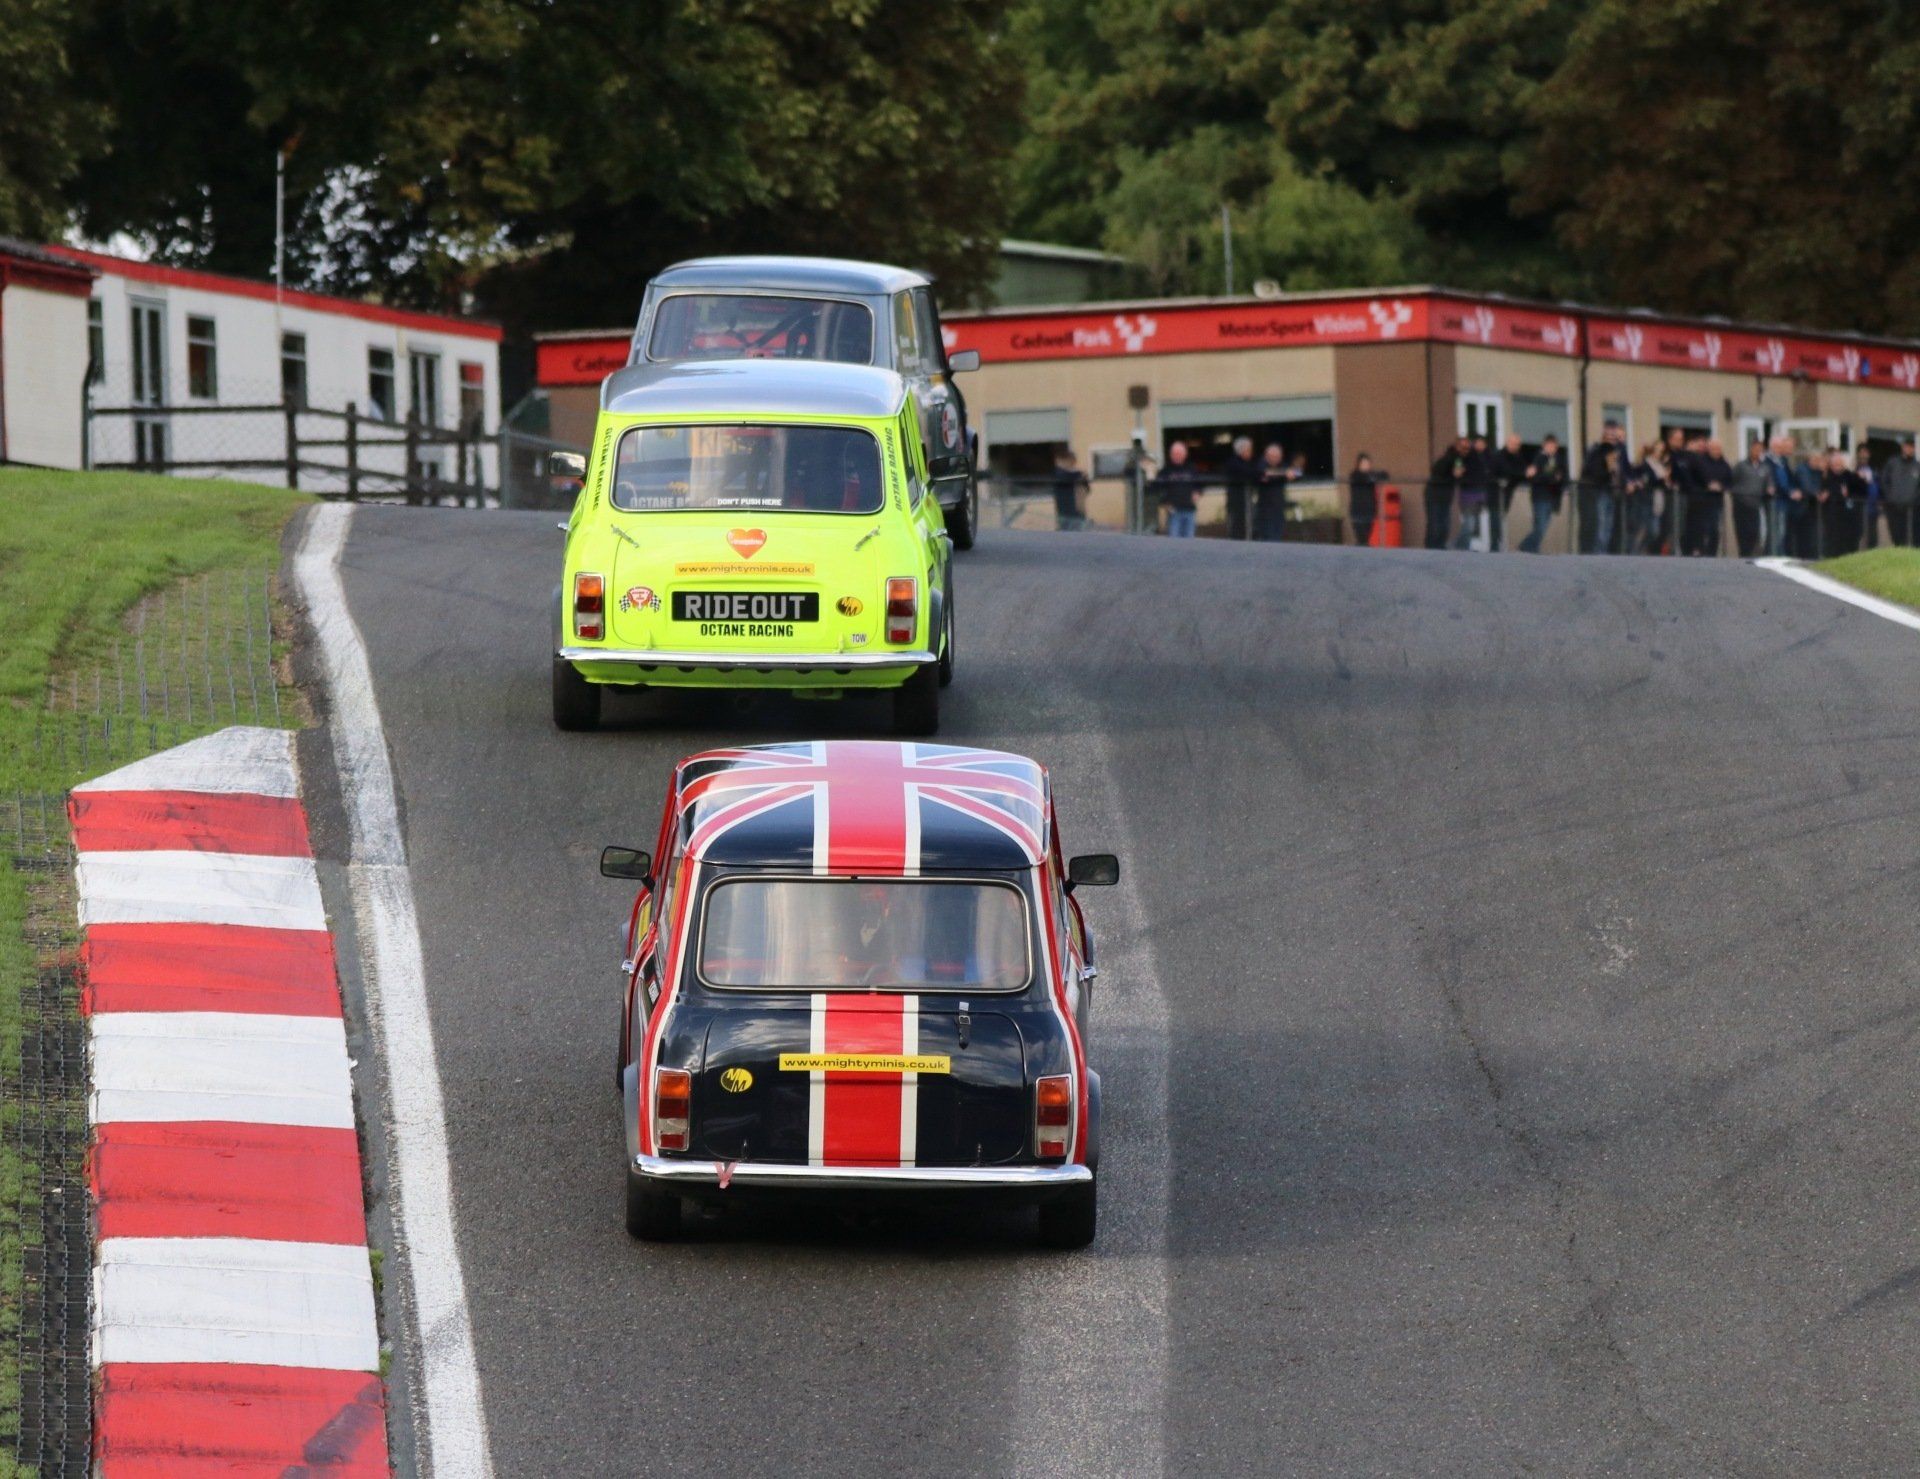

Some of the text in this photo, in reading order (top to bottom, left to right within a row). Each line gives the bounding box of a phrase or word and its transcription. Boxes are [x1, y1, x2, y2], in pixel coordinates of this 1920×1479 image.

[717, 498, 740, 506] DON'T
[741, 498, 761, 507] PUSH
[762, 499, 783, 507] HERE
[678, 564, 811, 575] www.mightyminis.co.uk
[685, 594, 806, 620] RIDEOUT
[700, 623, 794, 638] OCTANE RACING
[852, 633, 867, 644] TOW
[784, 1057, 945, 1070] www.mightyminis.co.uk
